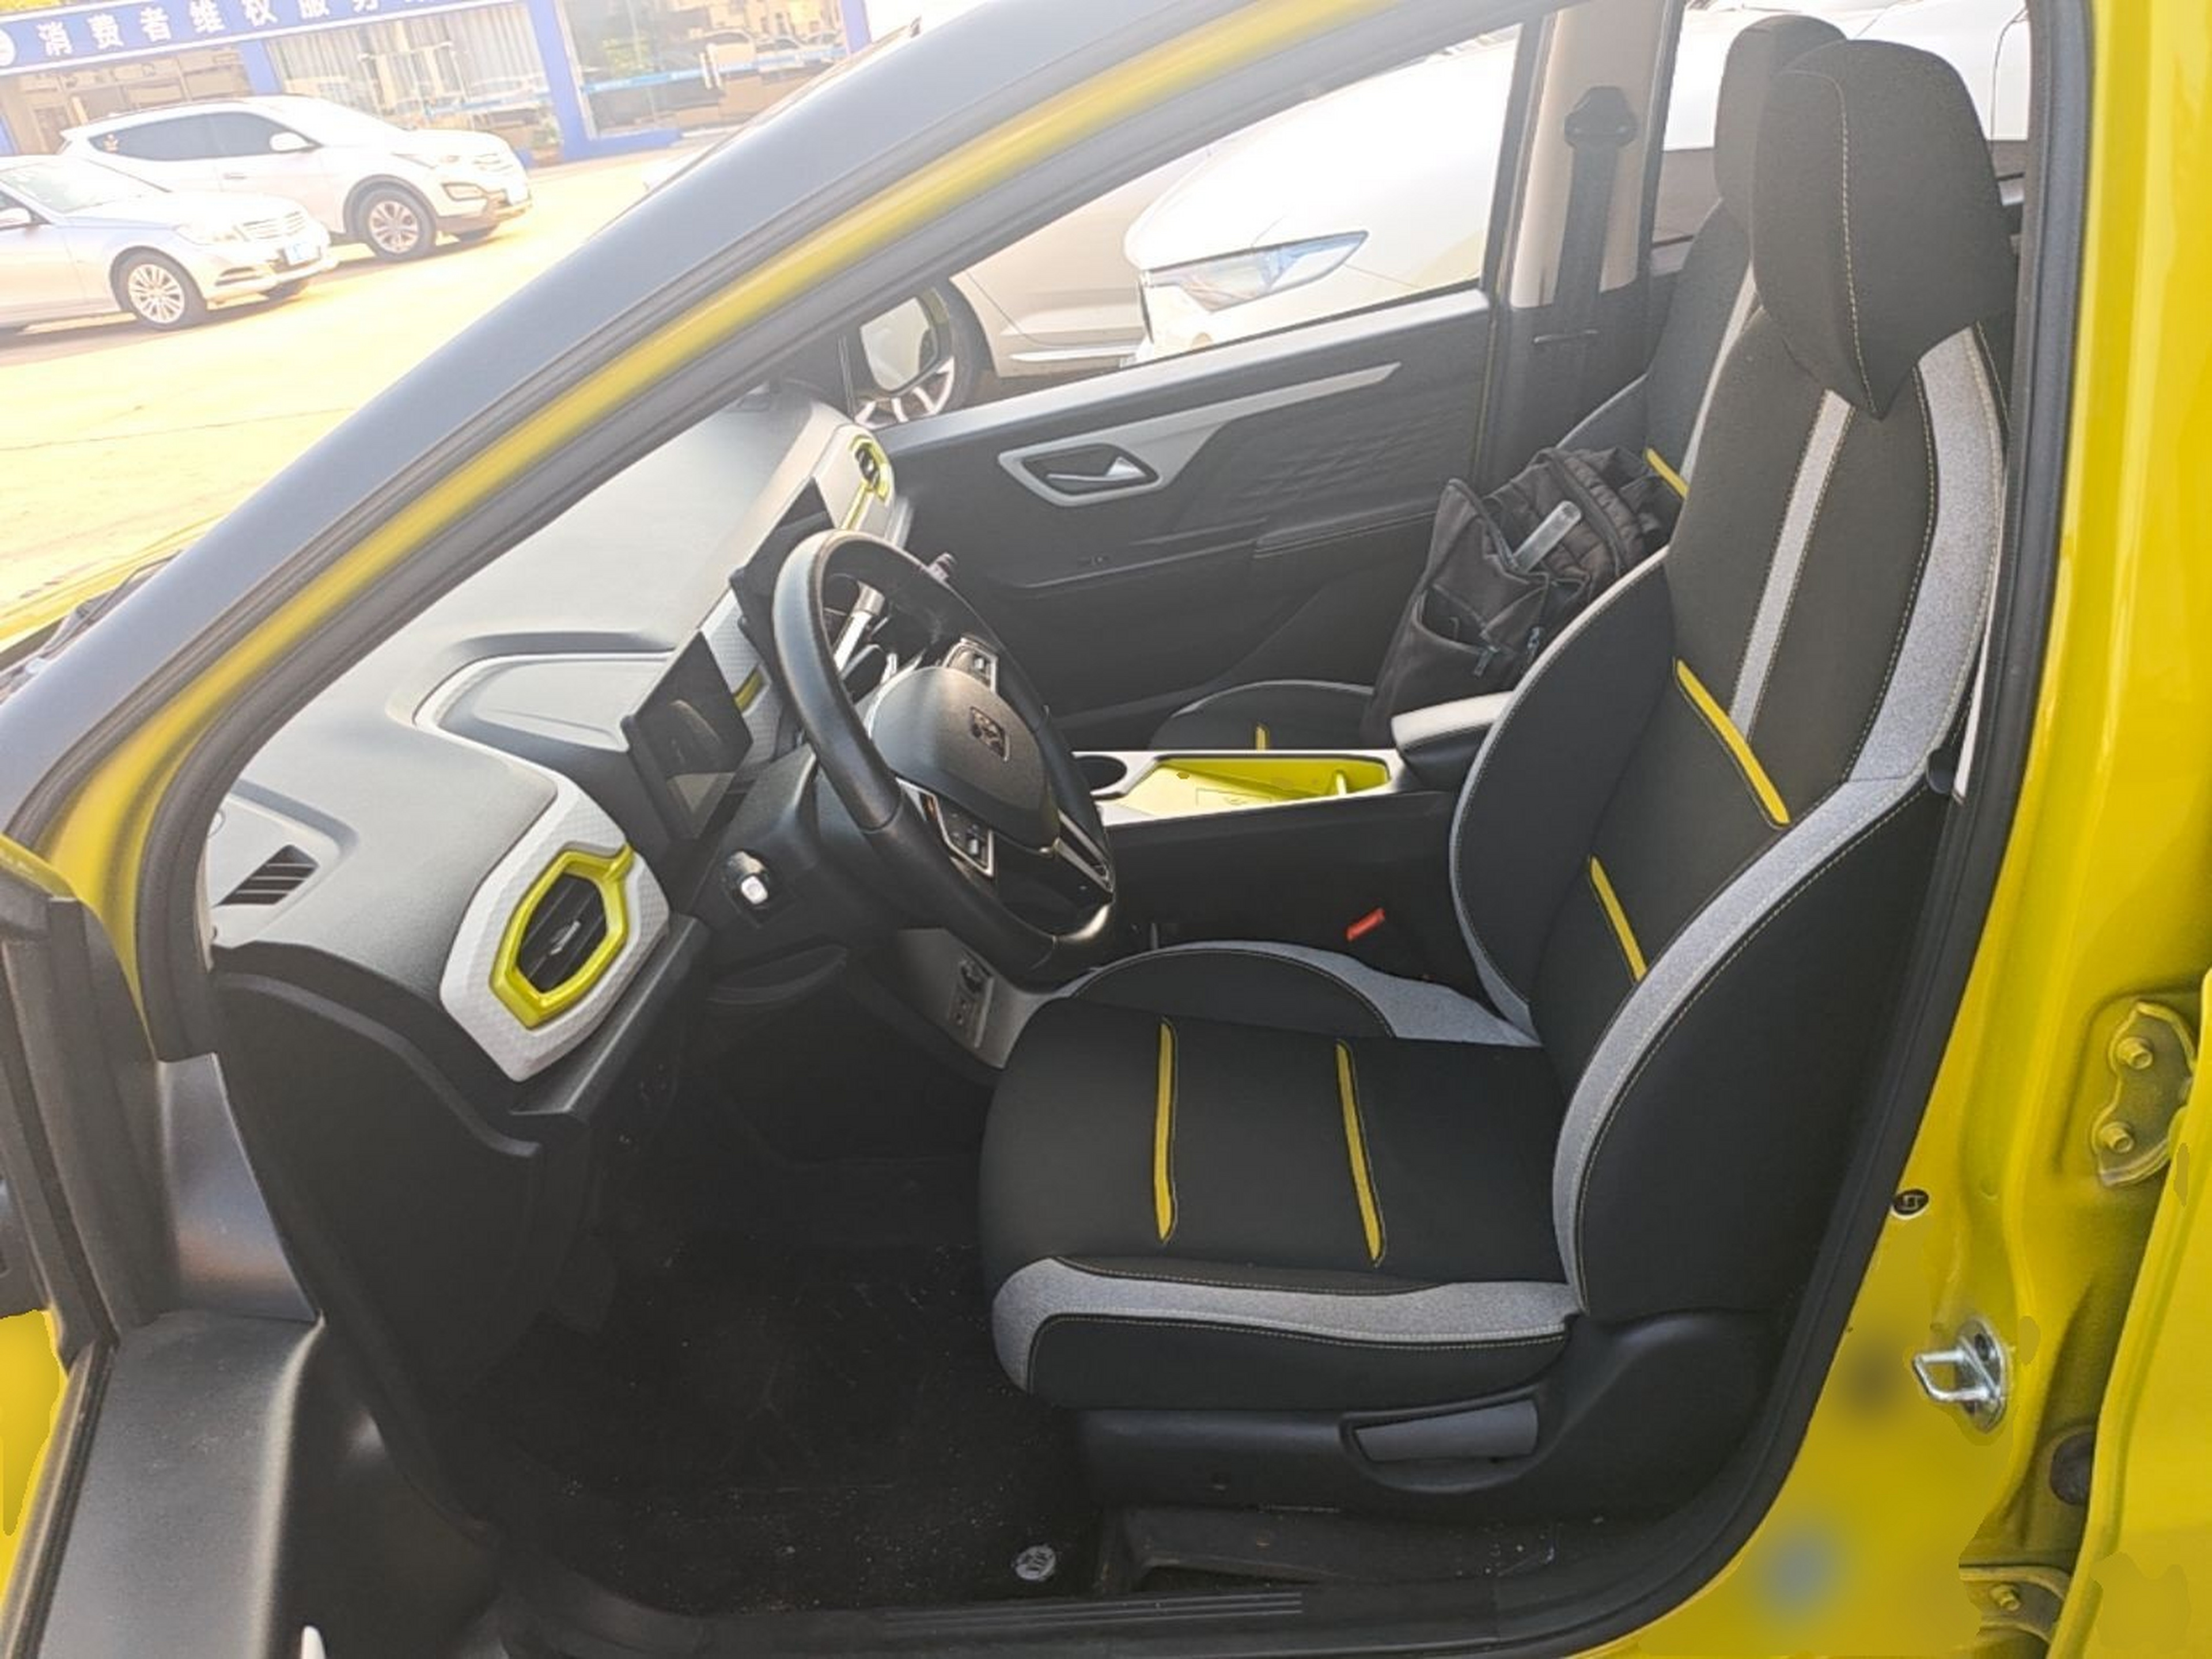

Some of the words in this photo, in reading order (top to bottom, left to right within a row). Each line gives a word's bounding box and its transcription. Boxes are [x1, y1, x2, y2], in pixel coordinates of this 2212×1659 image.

[36, 0, 424, 56] 消费者维权服
